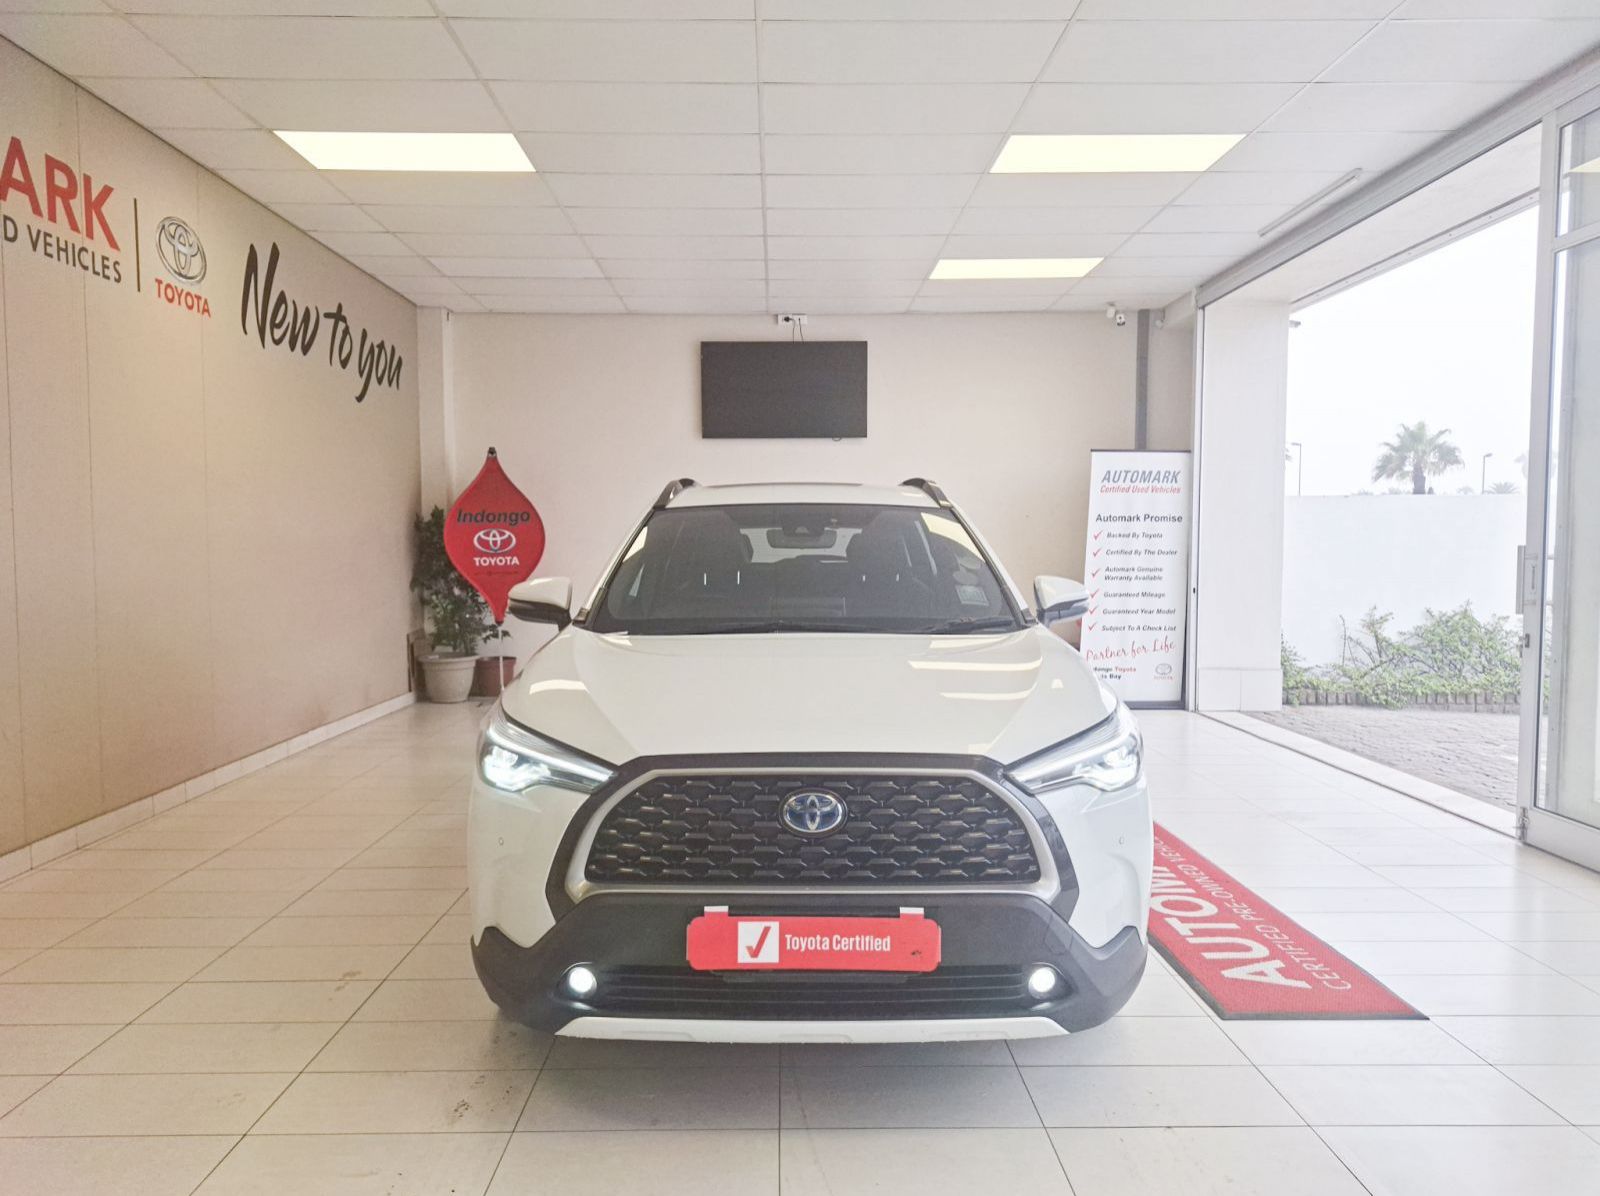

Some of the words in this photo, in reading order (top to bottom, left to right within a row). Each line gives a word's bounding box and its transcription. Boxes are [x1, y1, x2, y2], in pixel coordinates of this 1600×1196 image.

[0, 136, 121, 251] ARK
[27, 224, 122, 284] VEHICLES
[155, 278, 211, 318] TOYOTA
[241, 242, 319, 356] New
[324, 302, 353, 368] to
[355, 328, 403, 403] you
[1102, 470, 1181, 484] AUTOMARK
[1100, 485, 1130, 494] Certified
[1151, 486, 1181, 494] Vehicles
[457, 509, 531, 526] Indongo
[1096, 514, 1141, 523] Automark
[1144, 514, 1183, 523] Promise
[473, 557, 520, 567] TOYOTA
[1141, 591, 1166, 599] Mileage
[1086, 646, 1128, 662] Partner
[1129, 640, 1149, 659] for
[1153, 635, 1175, 653] Life
[1177, 864, 1258, 922] PRE-OWNED
[785, 934, 830, 952] Toyota
[832, 934, 891, 952] Certified
[1256, 924, 1352, 991] CERTIFIED
